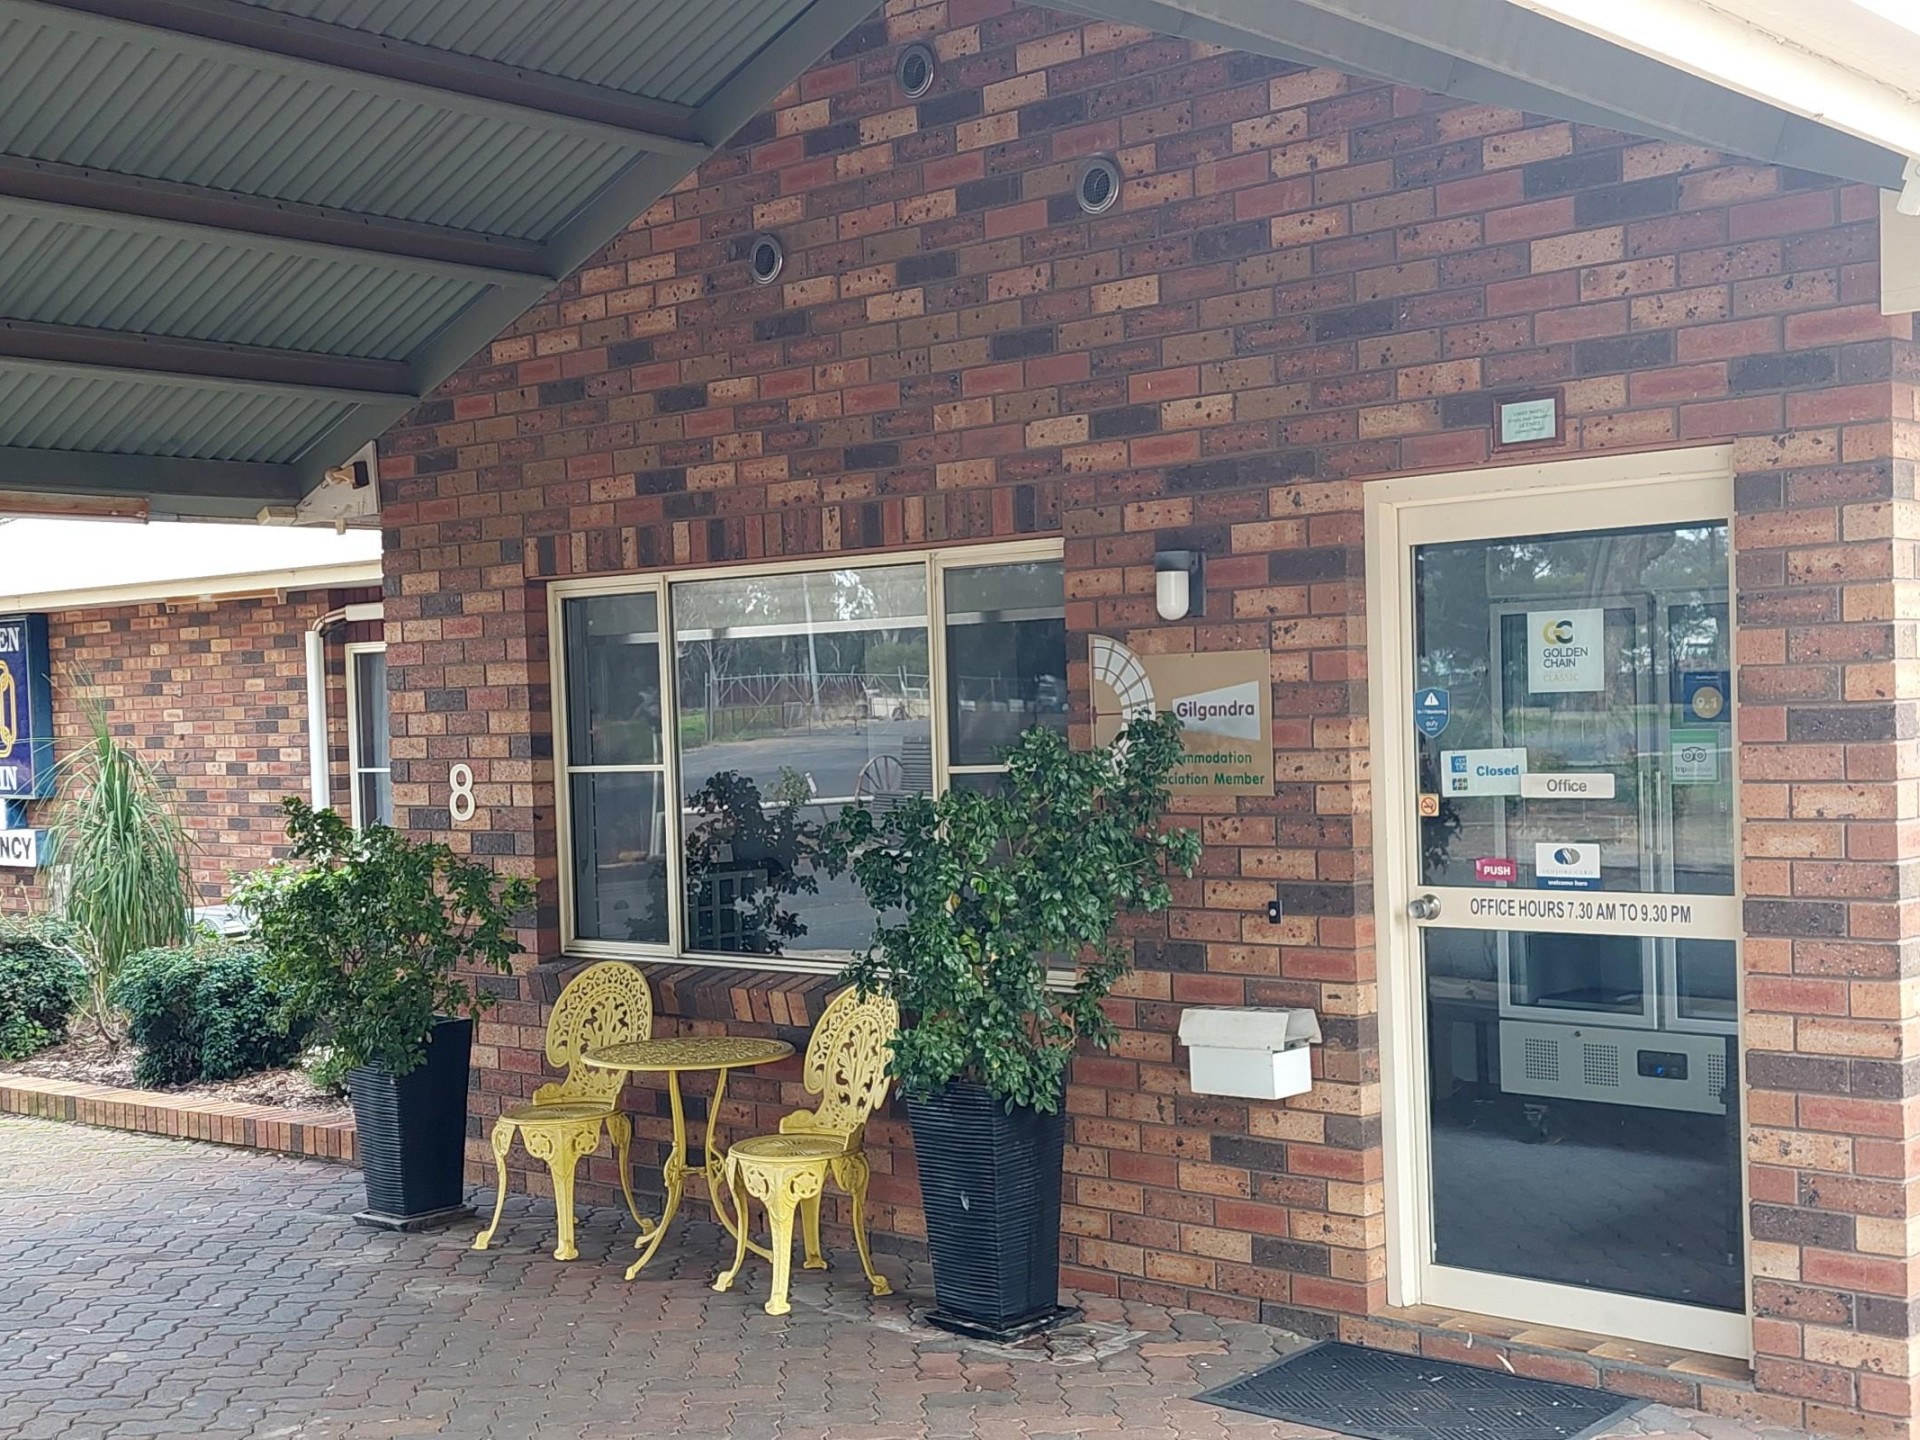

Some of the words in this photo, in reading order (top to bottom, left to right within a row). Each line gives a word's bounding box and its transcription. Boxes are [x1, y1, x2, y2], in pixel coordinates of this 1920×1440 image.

[0, 626, 20, 652] EN
[1543, 647, 1589, 658] GOLDEN
[1543, 658, 1576, 668] CHAIN
[1543, 673, 1580, 682] CLASSIC
[1176, 700, 1255, 720] Gilgandra
[1183, 751, 1252, 763] mmodation
[1476, 765, 1519, 776] Closed
[1162, 772, 1208, 784] ociation
[1214, 772, 1265, 785] Member
[450, 764, 475, 820] 8
[1546, 779, 1587, 793] Office
[0, 836, 31, 859] NCY
[1483, 866, 1511, 875] PUSH
[1470, 897, 1516, 917] OFFICE
[1519, 900, 1564, 918] HOURS
[1568, 901, 1593, 920] 7.30
[1596, 903, 1616, 921] AM
[1621, 903, 1638, 921] TO
[1641, 904, 1667, 922] 9.30
[1671, 905, 1691, 923] PM
